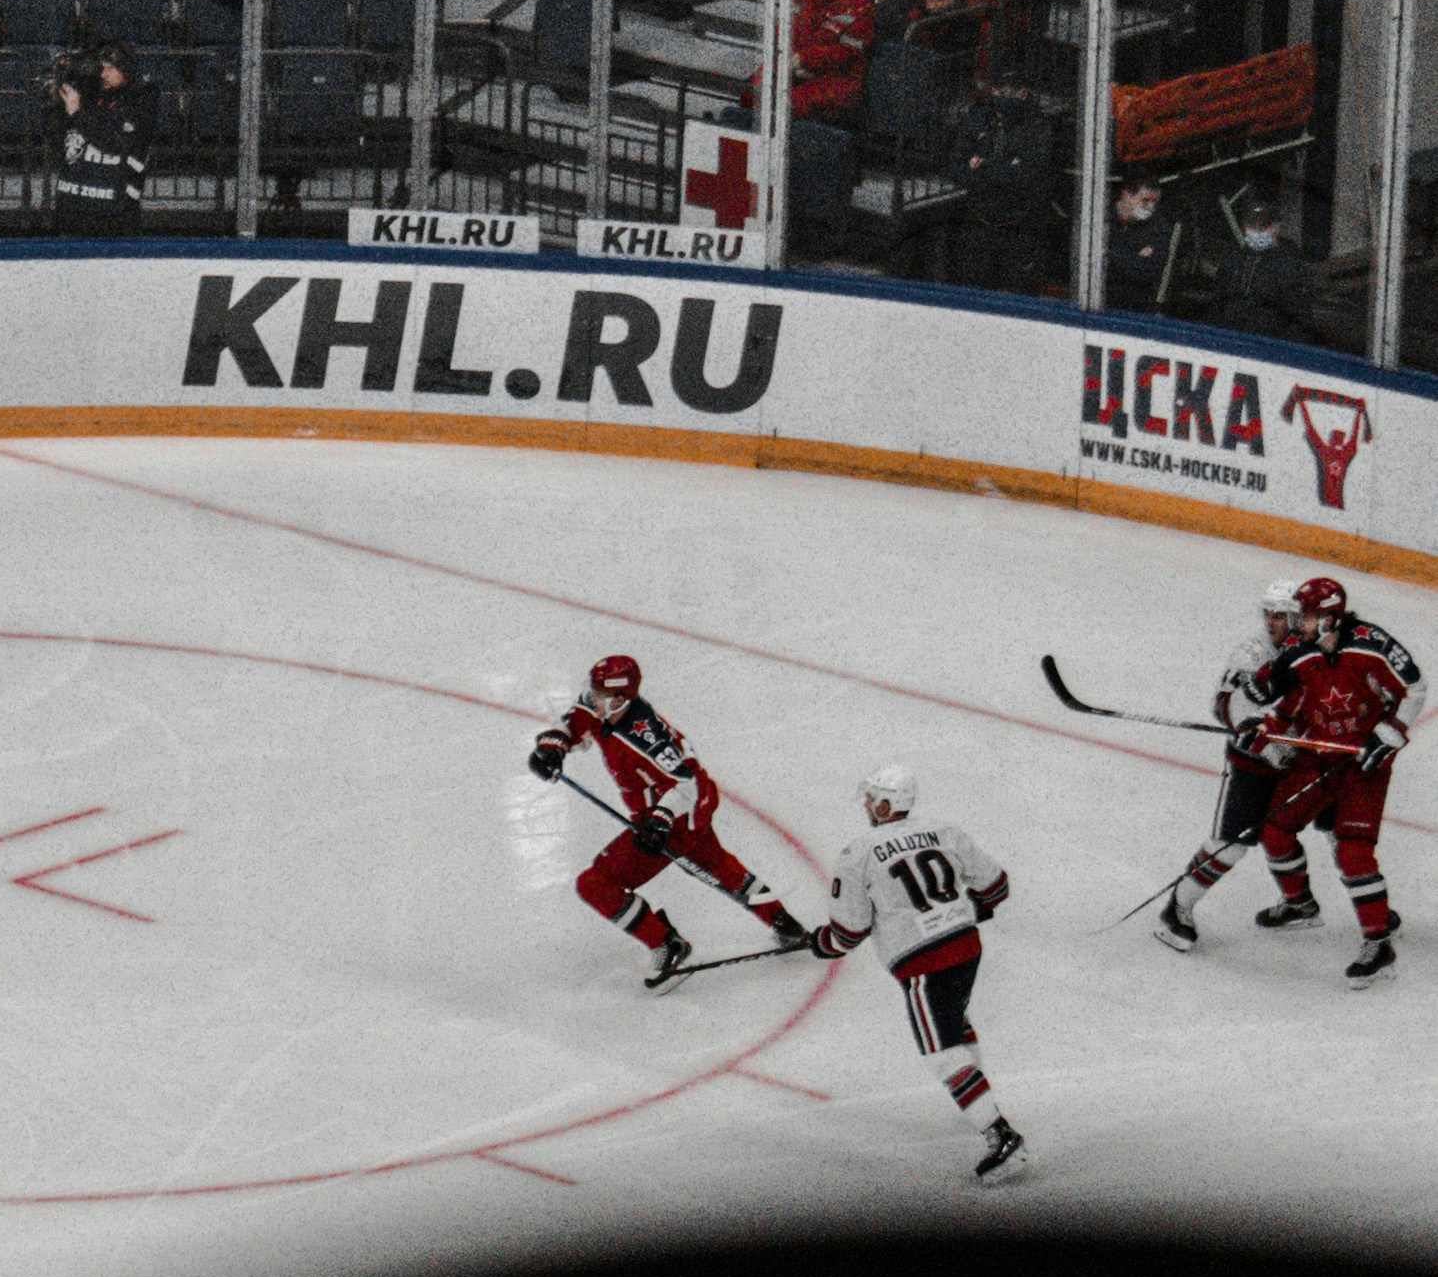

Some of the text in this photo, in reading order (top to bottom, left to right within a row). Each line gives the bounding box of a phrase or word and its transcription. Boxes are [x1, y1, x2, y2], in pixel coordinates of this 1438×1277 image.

[372, 214, 515, 249] KHL.RU
[601, 226, 743, 262] KHL.RU
[182, 275, 783, 414] KHL.RU
[1082, 344, 1265, 457] ЦСКА
[1080, 439, 1266, 493] WWW.CSKA-HOCKEY.RU
[874, 832, 940, 862] GALUZIN
[889, 849, 959, 913] 10
